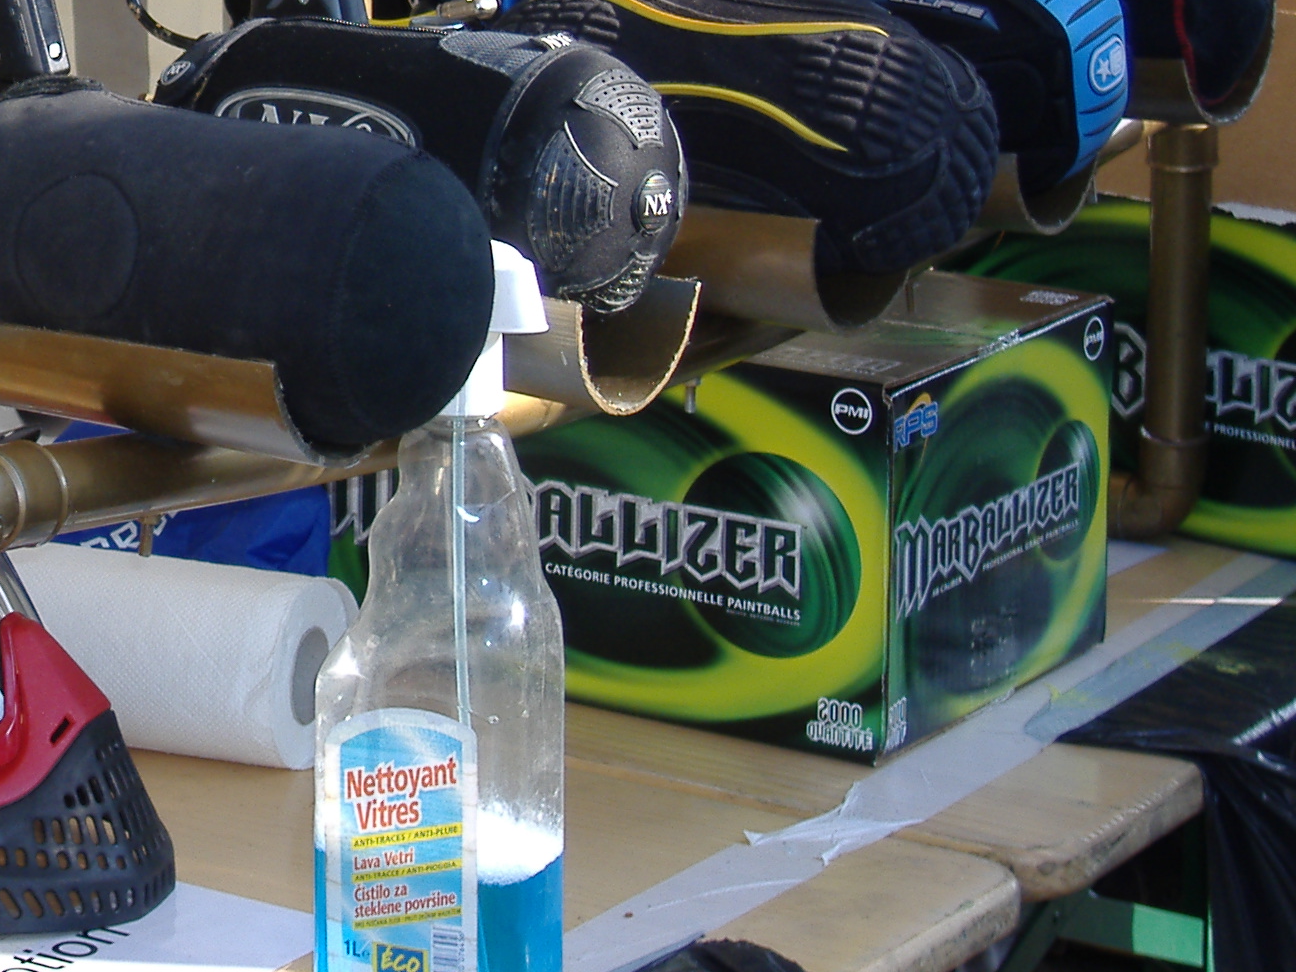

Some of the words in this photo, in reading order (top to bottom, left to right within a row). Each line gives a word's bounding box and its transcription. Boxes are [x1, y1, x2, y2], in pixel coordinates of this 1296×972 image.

[834, 403, 869, 420] PMI
[894, 401, 939, 453] RPS
[894, 462, 1080, 625] MARBALLIZER
[545, 561, 611, 585] CATÉGORIE
[613, 575, 724, 607] PROFESSIONNELLE
[726, 596, 801, 621] PAINTBALLS
[817, 697, 863, 729] 2000
[806, 720, 874, 751] QUANTITÉ
[346, 757, 457, 799] Nettoyant
[356, 798, 420, 831] Vitres
[354, 833, 406, 848] ANTI-TRACES
[413, 826, 458, 840] ANTI-PLUIE
[354, 855, 381, 872] Lava
[384, 848, 414, 867] Vetri
[354, 883, 391, 903] Čistilo
[394, 885, 408, 897] za
[354, 899, 402, 919] steklene
[404, 890, 456, 914] površine
[2, 926, 131, 972] tion
